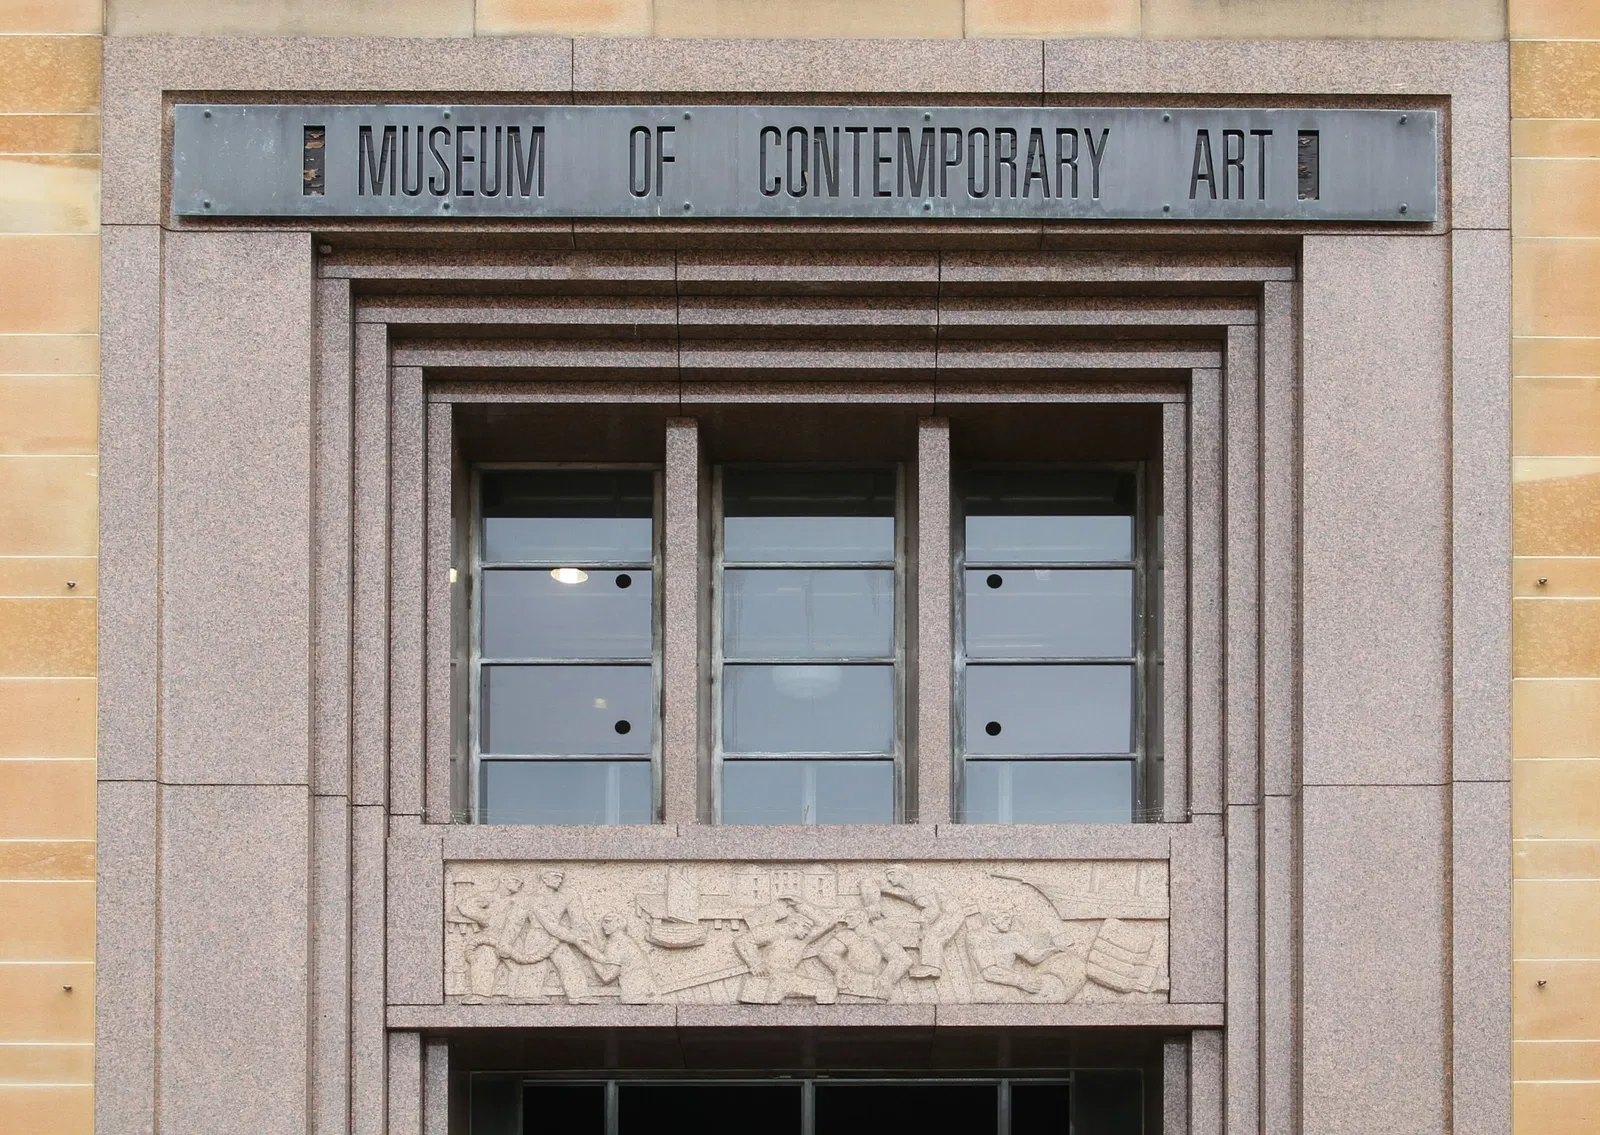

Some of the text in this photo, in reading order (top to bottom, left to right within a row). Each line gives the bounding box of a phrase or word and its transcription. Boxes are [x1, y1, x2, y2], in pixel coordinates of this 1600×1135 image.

[358, 125, 1274, 200] MUSEUM OF CONTEMPORARY ART
